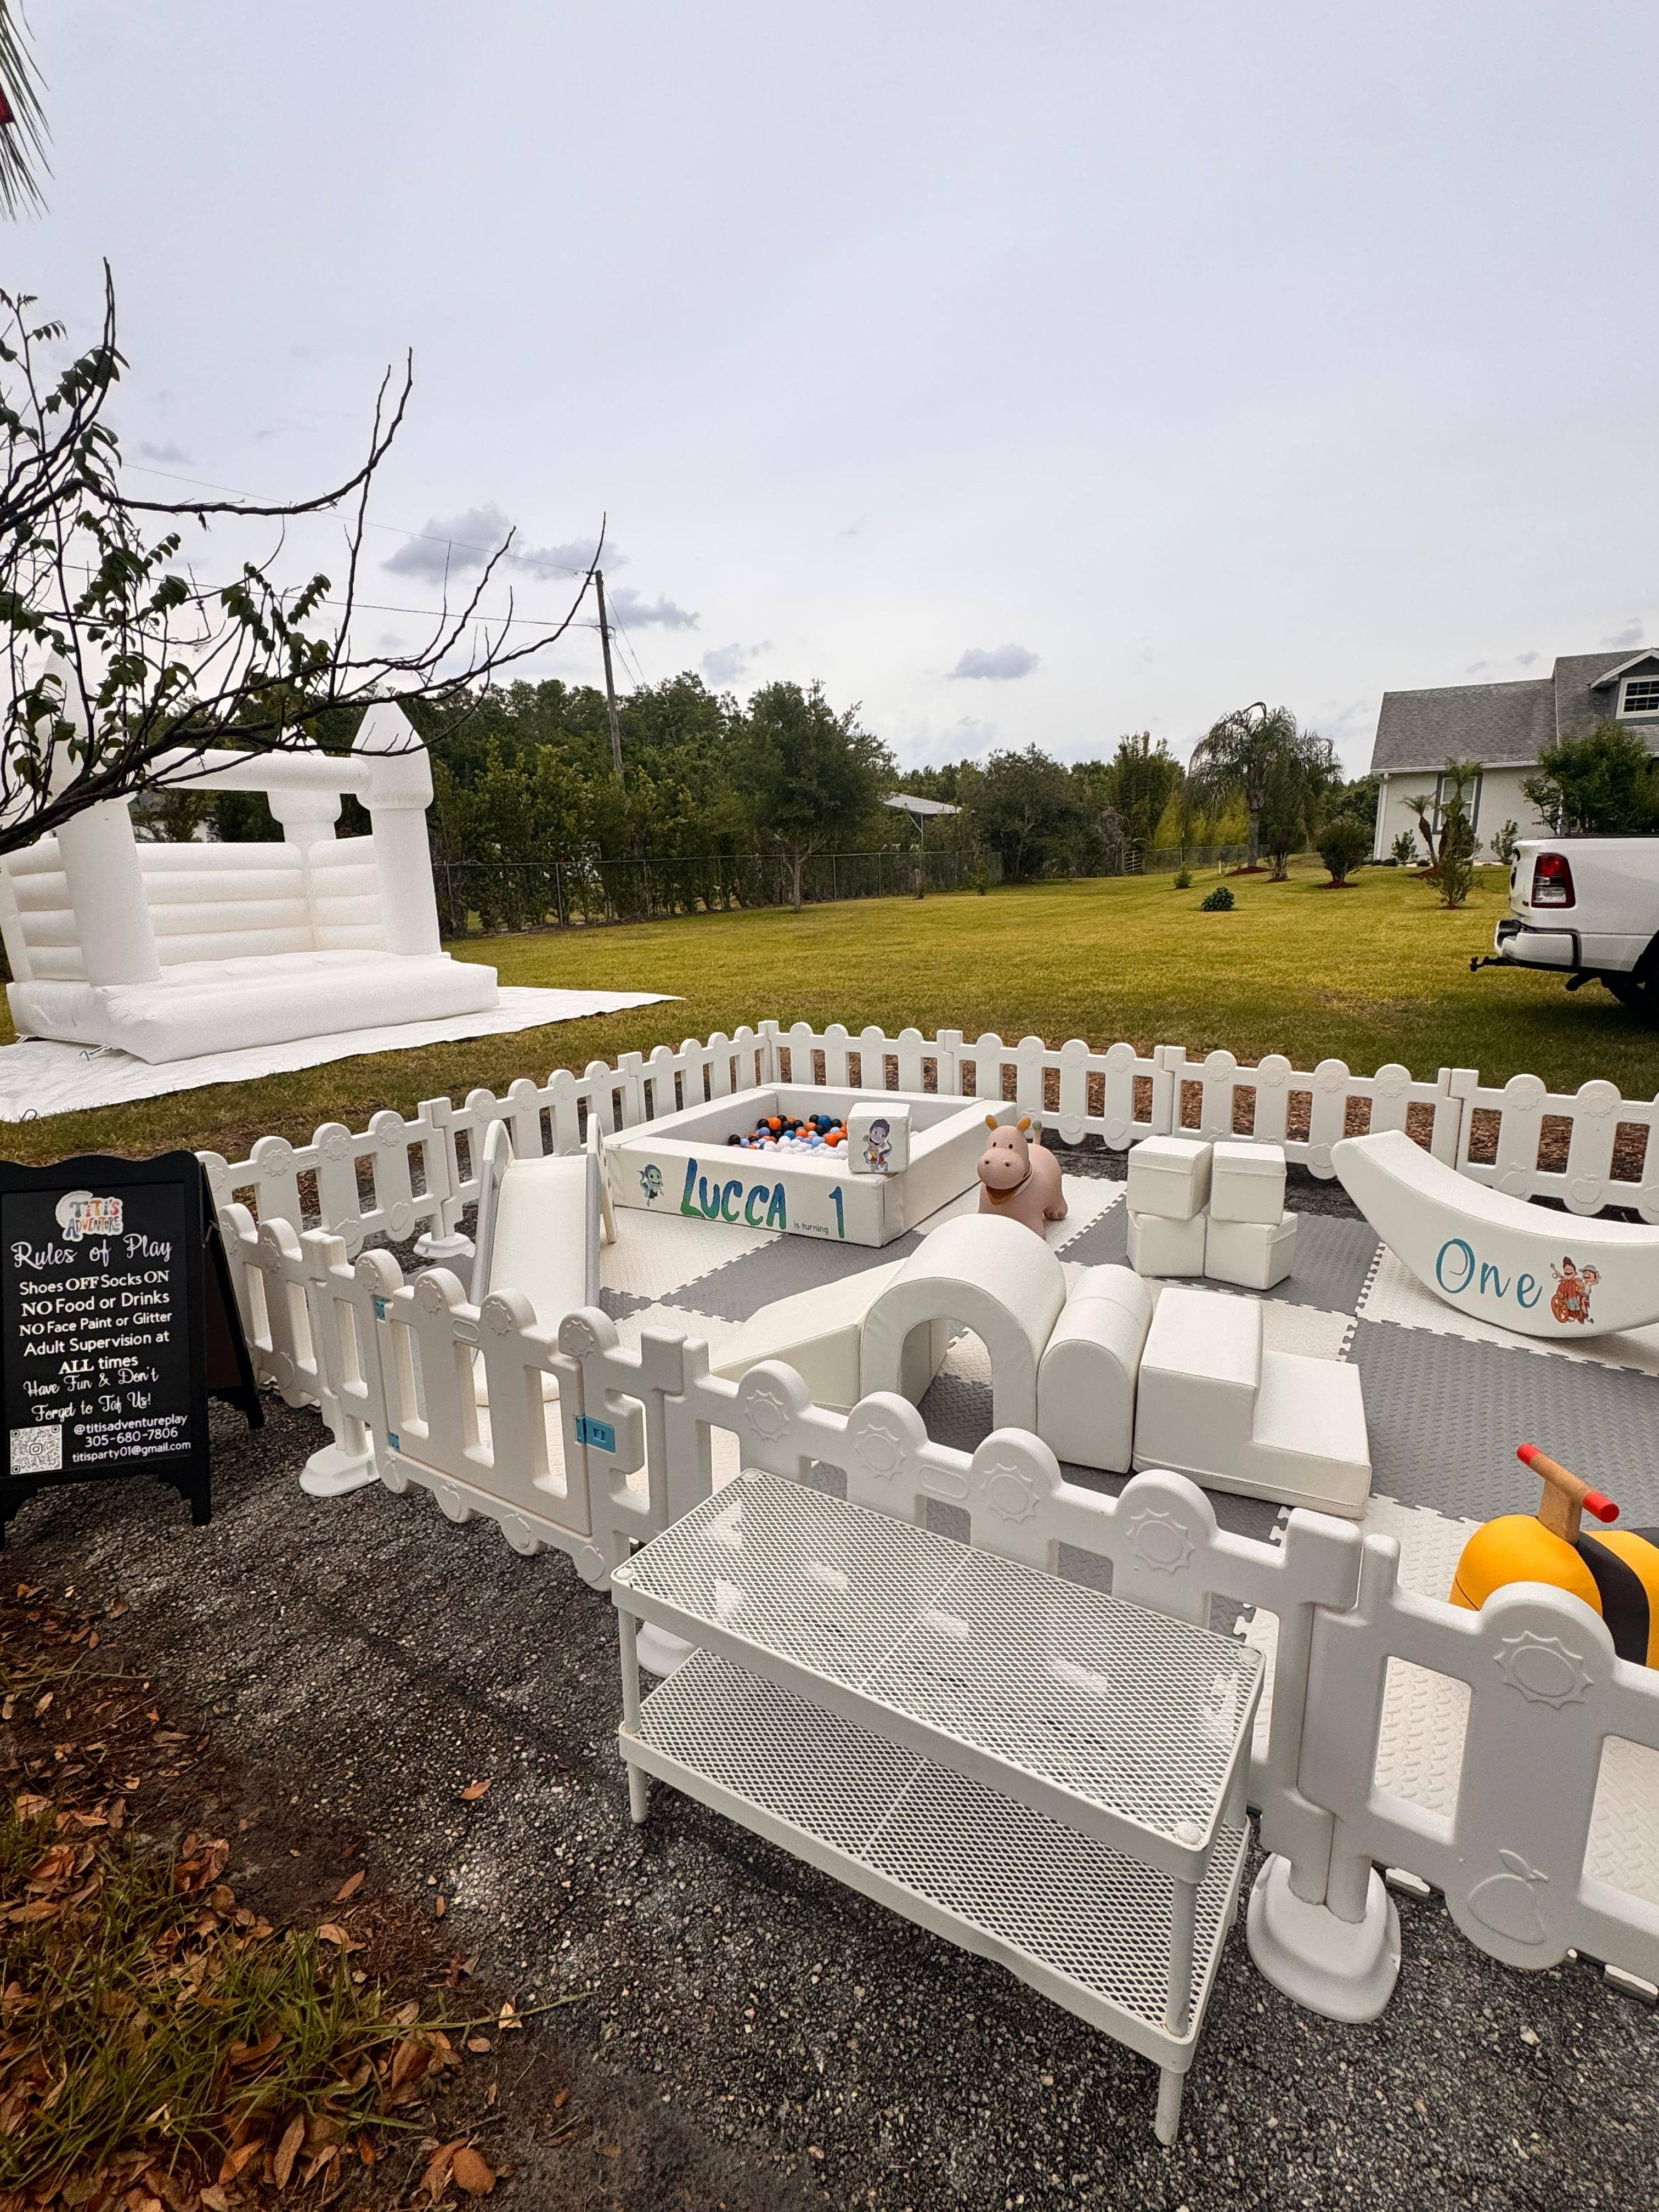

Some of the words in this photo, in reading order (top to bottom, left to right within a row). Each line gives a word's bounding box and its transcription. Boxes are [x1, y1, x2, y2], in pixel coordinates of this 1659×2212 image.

[680, 1158, 787, 1229] LUCCA
[793, 1220, 799, 1229] is
[802, 1222, 829, 1235] turning
[828, 1186, 844, 1238] 1
[65, 1216, 120, 1239] ADVENTURE
[10, 1242, 77, 1270] Rules
[89, 1239, 111, 1267] of
[123, 1233, 172, 1262] Play
[19, 1282, 63, 1295] Shoes
[65, 1276, 99, 1291] OFF
[100, 1273, 142, 1288] Socks
[144, 1270, 170, 1283] ON
[1436, 1238, 1542, 1308] One
[21, 1301, 52, 1317] NO
[56, 1296, 94, 1313] Food
[99, 1297, 116, 1309] or
[121, 1290, 170, 1307] Drinks
[19, 1323, 44, 1336] NO
[47, 1321, 76, 1334] Face
[81, 1318, 112, 1330] Paint
[115, 1317, 129, 1327] or
[133, 1312, 172, 1324] Glitter
[23, 1340, 65, 1357] Adult
[70, 1333, 151, 1352] Supervision
[156, 1330, 170, 1342] at
[58, 1359, 94, 1374] ALL
[98, 1356, 138, 1369] times
[23, 1380, 60, 1397] Have
[63, 1374, 93, 1392] Fun
[98, 1373, 110, 1387] &
[118, 1366, 159, 1385] Don't
[31, 1402, 76, 1423] Forget
[81, 1400, 93, 1415] to
[127, 1391, 151, 1409] Us!
[74, 1414, 188, 1435] @titisadventureplay
[85, 1427, 178, 1447] 305-680-7806
[72, 1442, 191, 1463] titisparty01@gmail.com
